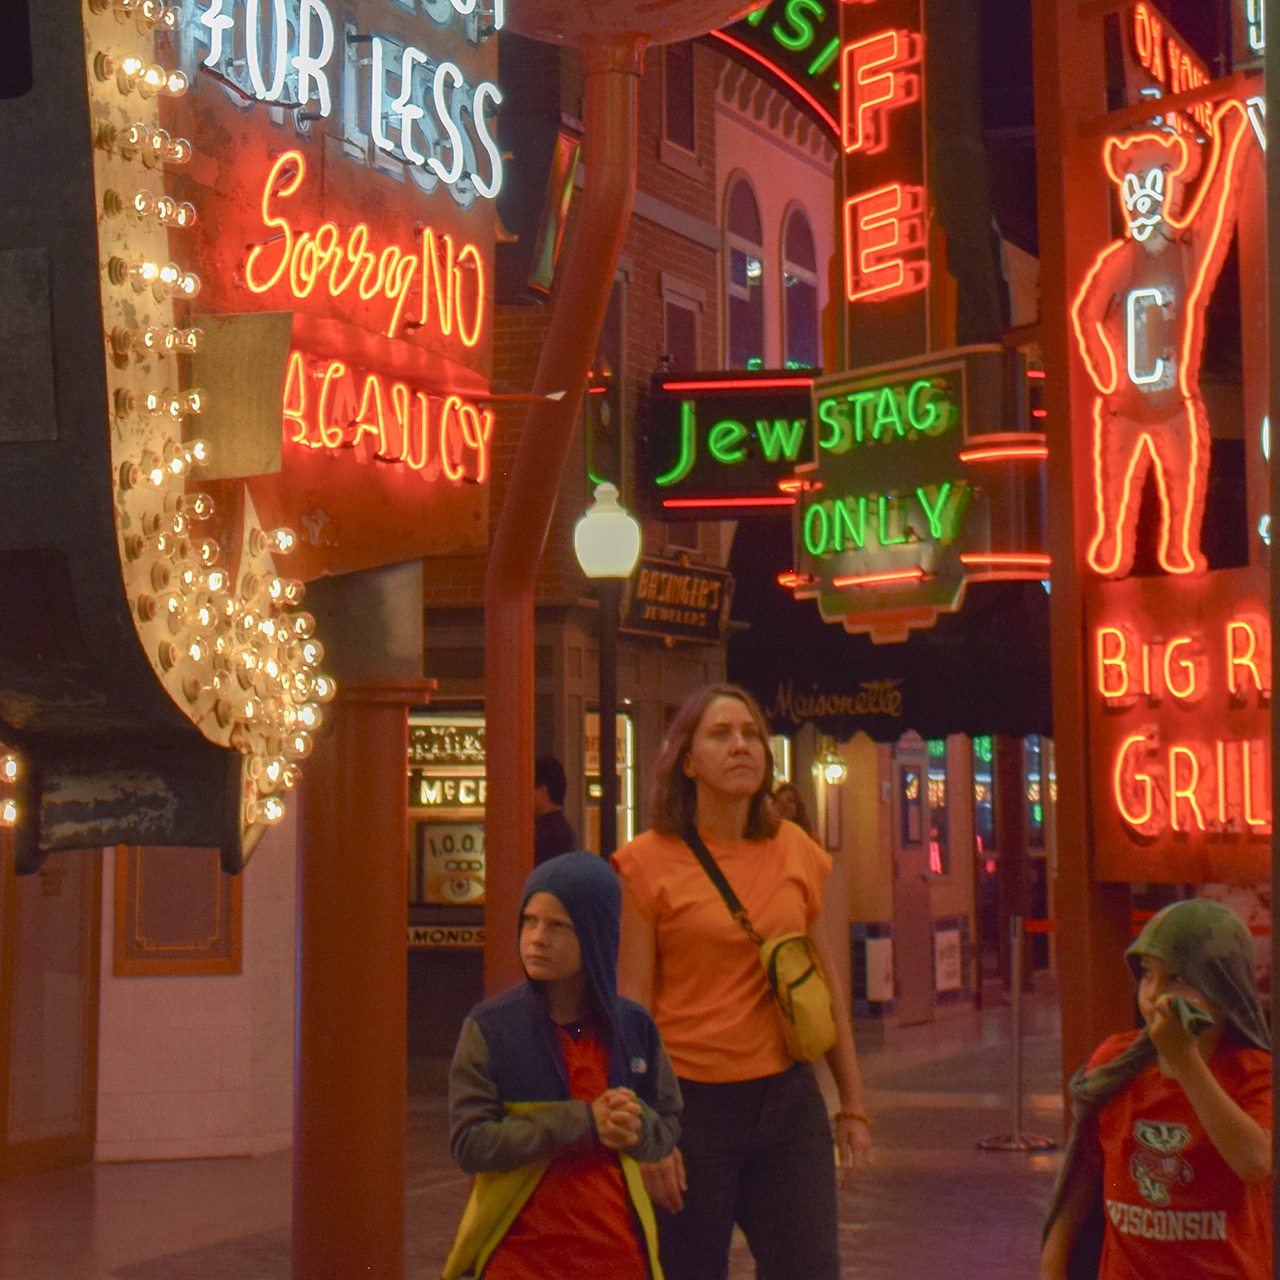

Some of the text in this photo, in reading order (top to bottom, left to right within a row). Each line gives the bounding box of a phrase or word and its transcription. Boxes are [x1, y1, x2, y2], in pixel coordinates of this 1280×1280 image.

[342, 20, 504, 208] LESS
[247, 150, 484, 347] Sorry NO
[280, 348, 498, 484] ACANCY
[819, 378, 956, 452] STAG
[804, 482, 970, 560] ONLY
[766, 677, 904, 724] Maisonette
[408, 928, 485, 944] MONDS
[1105, 1199, 1228, 1242] WISCONSIN
